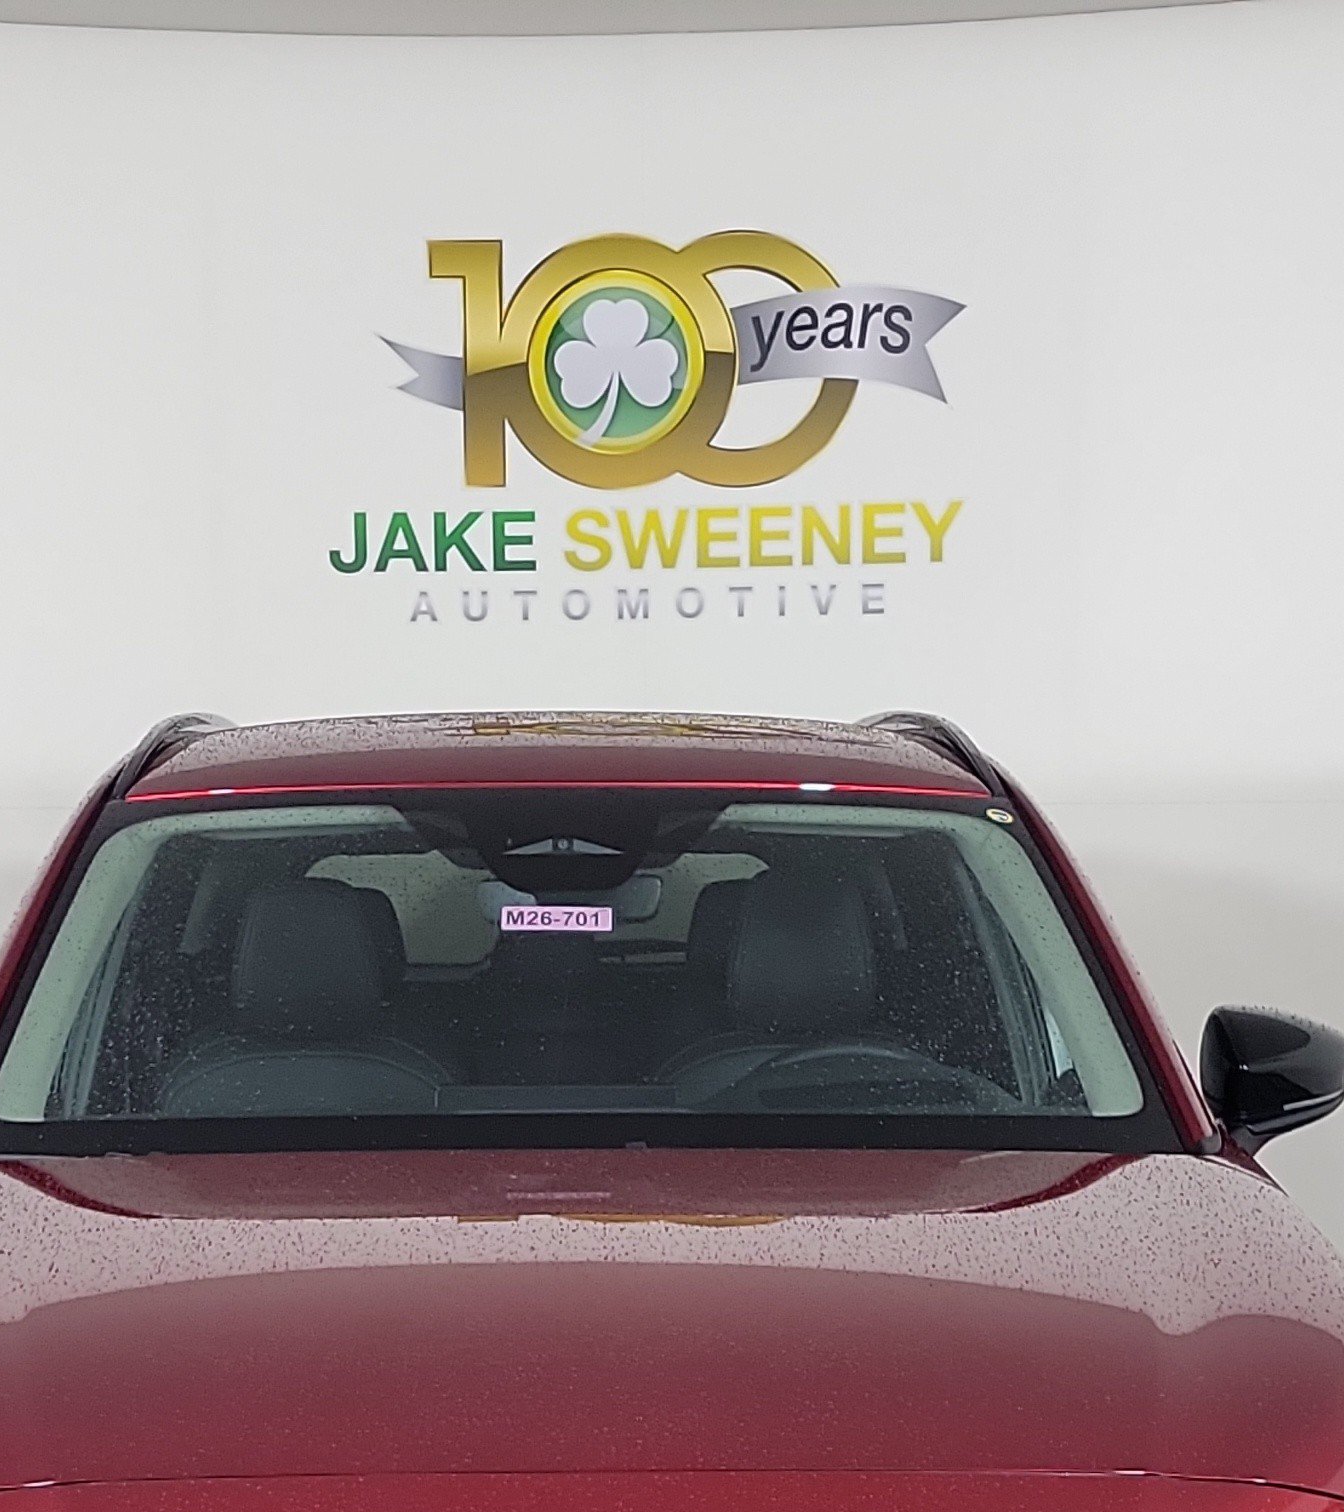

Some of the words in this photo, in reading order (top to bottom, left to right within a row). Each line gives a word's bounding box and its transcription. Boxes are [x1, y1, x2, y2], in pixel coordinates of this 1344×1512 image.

[426, 229, 858, 490] 100
[749, 297, 914, 374] years
[328, 509, 537, 574] JAKE
[564, 501, 964, 570] SWEENEY
[409, 583, 886, 623] AUTOMOTIVE
[506, 910, 599, 927] M26-701
